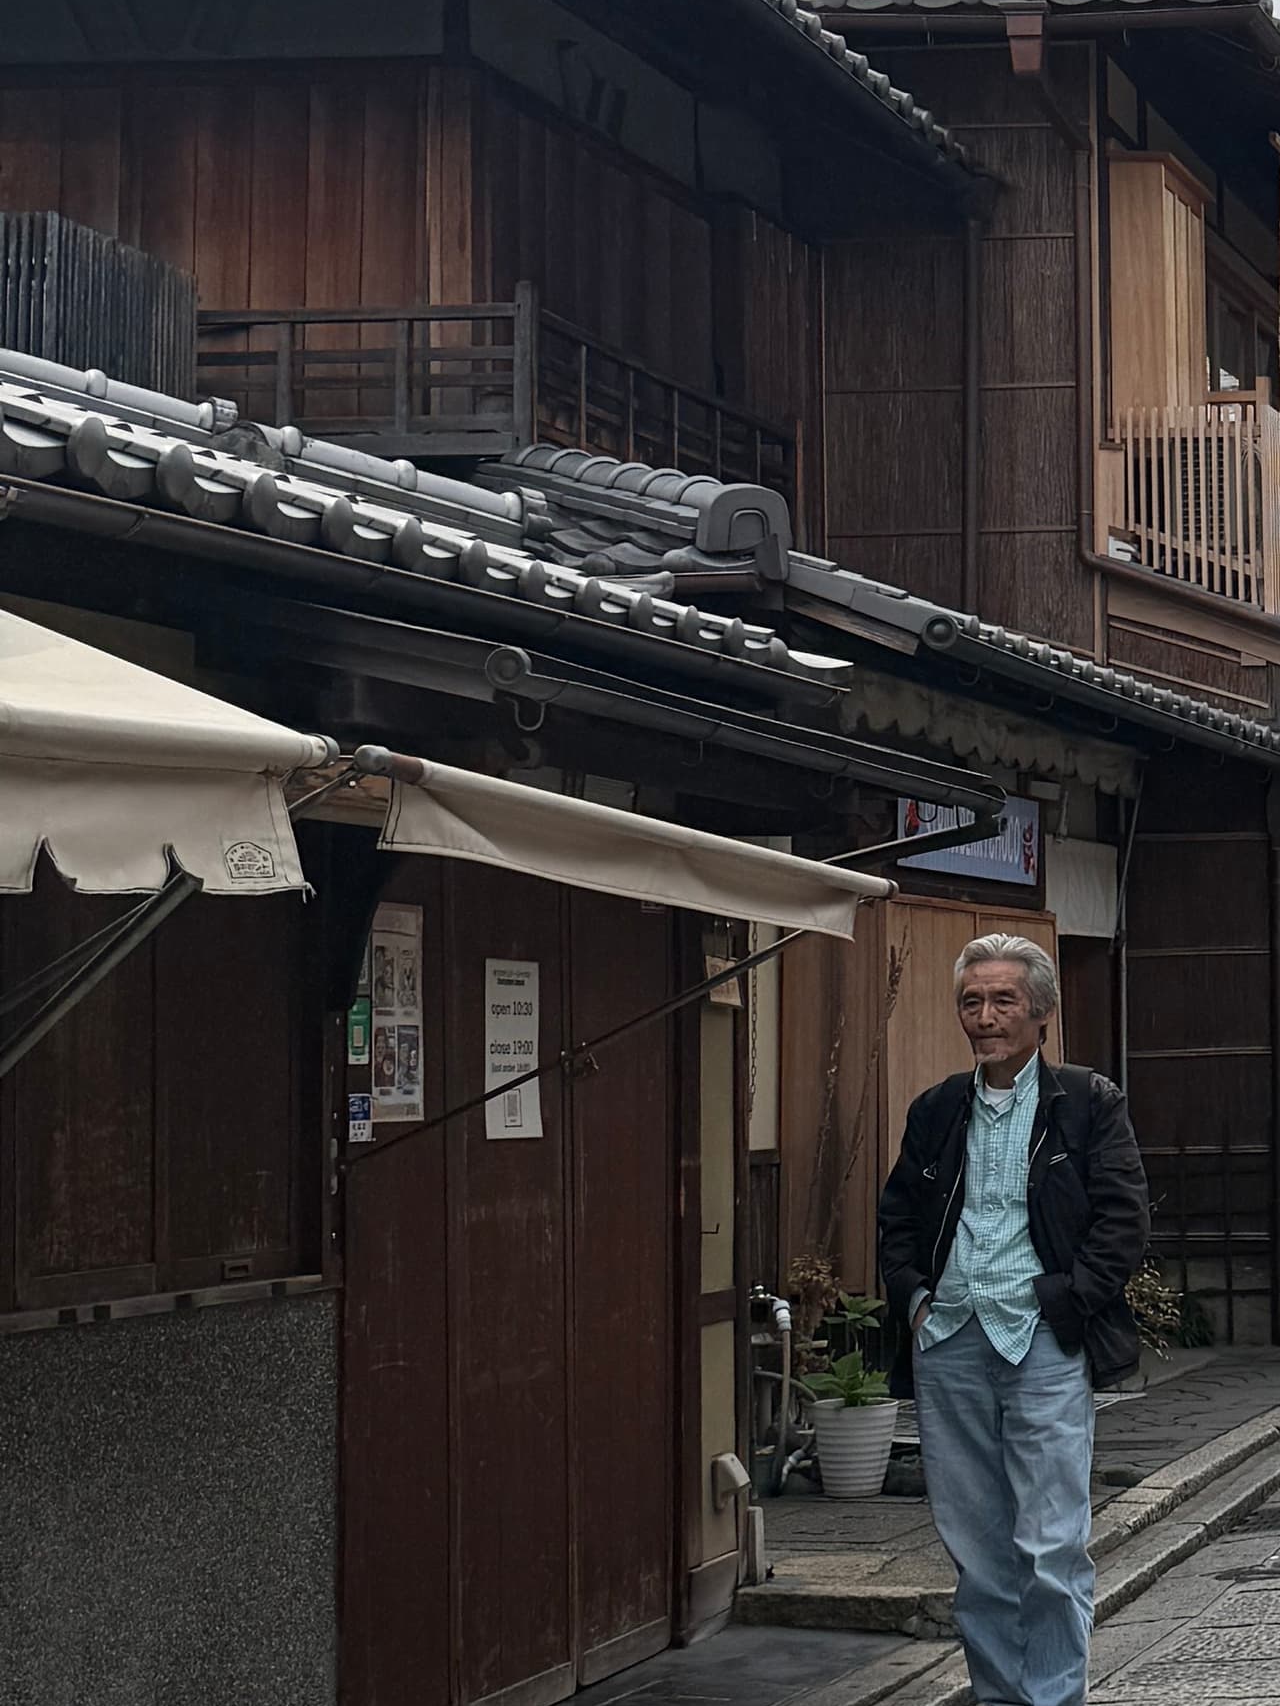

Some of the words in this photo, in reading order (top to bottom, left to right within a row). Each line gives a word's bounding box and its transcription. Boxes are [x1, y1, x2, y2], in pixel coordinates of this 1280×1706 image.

[491, 1003, 510, 1018] open
[513, 1001, 533, 1016] 10:30
[490, 1040, 510, 1054] close
[513, 1040, 533, 1054] 19:00
